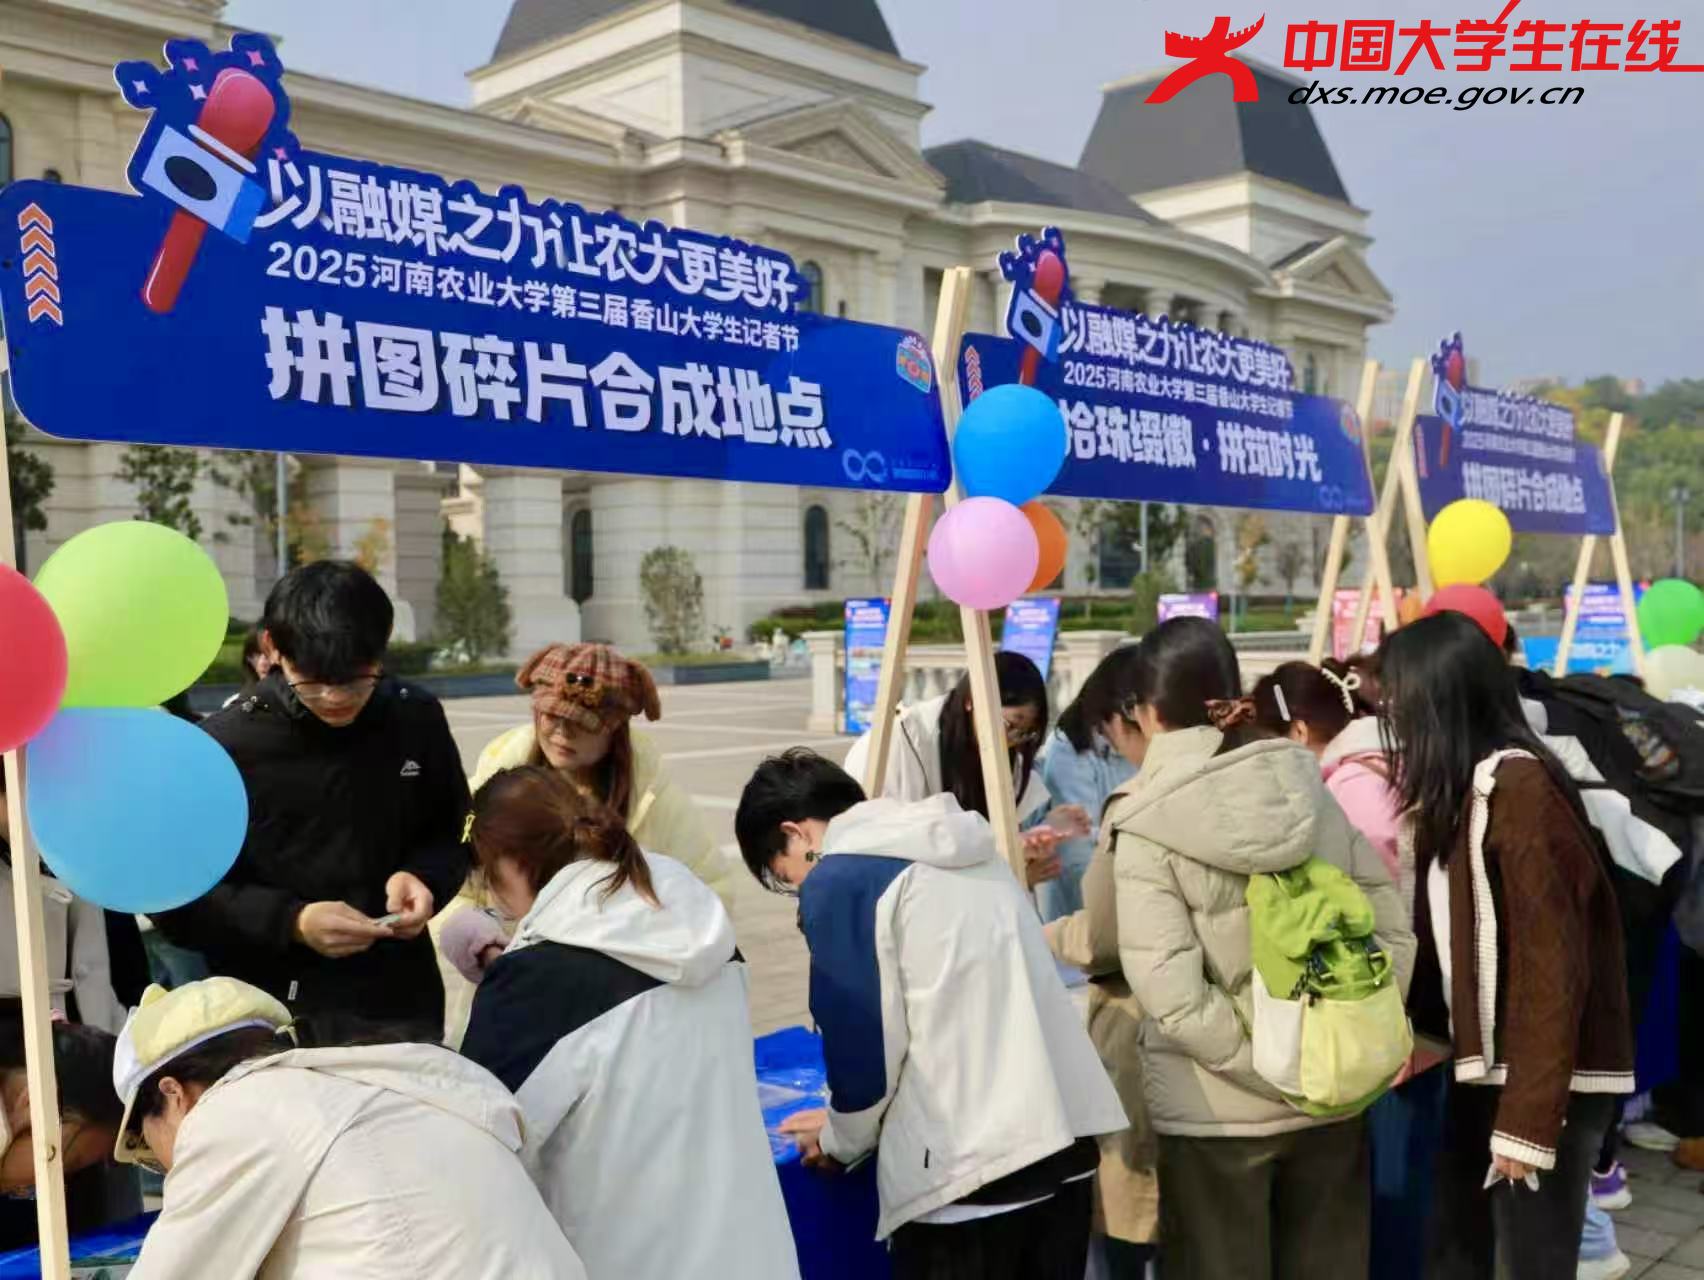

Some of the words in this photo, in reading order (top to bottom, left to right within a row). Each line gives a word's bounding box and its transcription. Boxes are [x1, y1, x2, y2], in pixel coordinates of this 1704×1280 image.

[253, 158, 797, 312] 以融媒之力让农大更美好
[266, 241, 799, 352] 2025河南农业大学第三届香山大学生记者节
[261, 306, 833, 449] 拼图碎片合成地点
